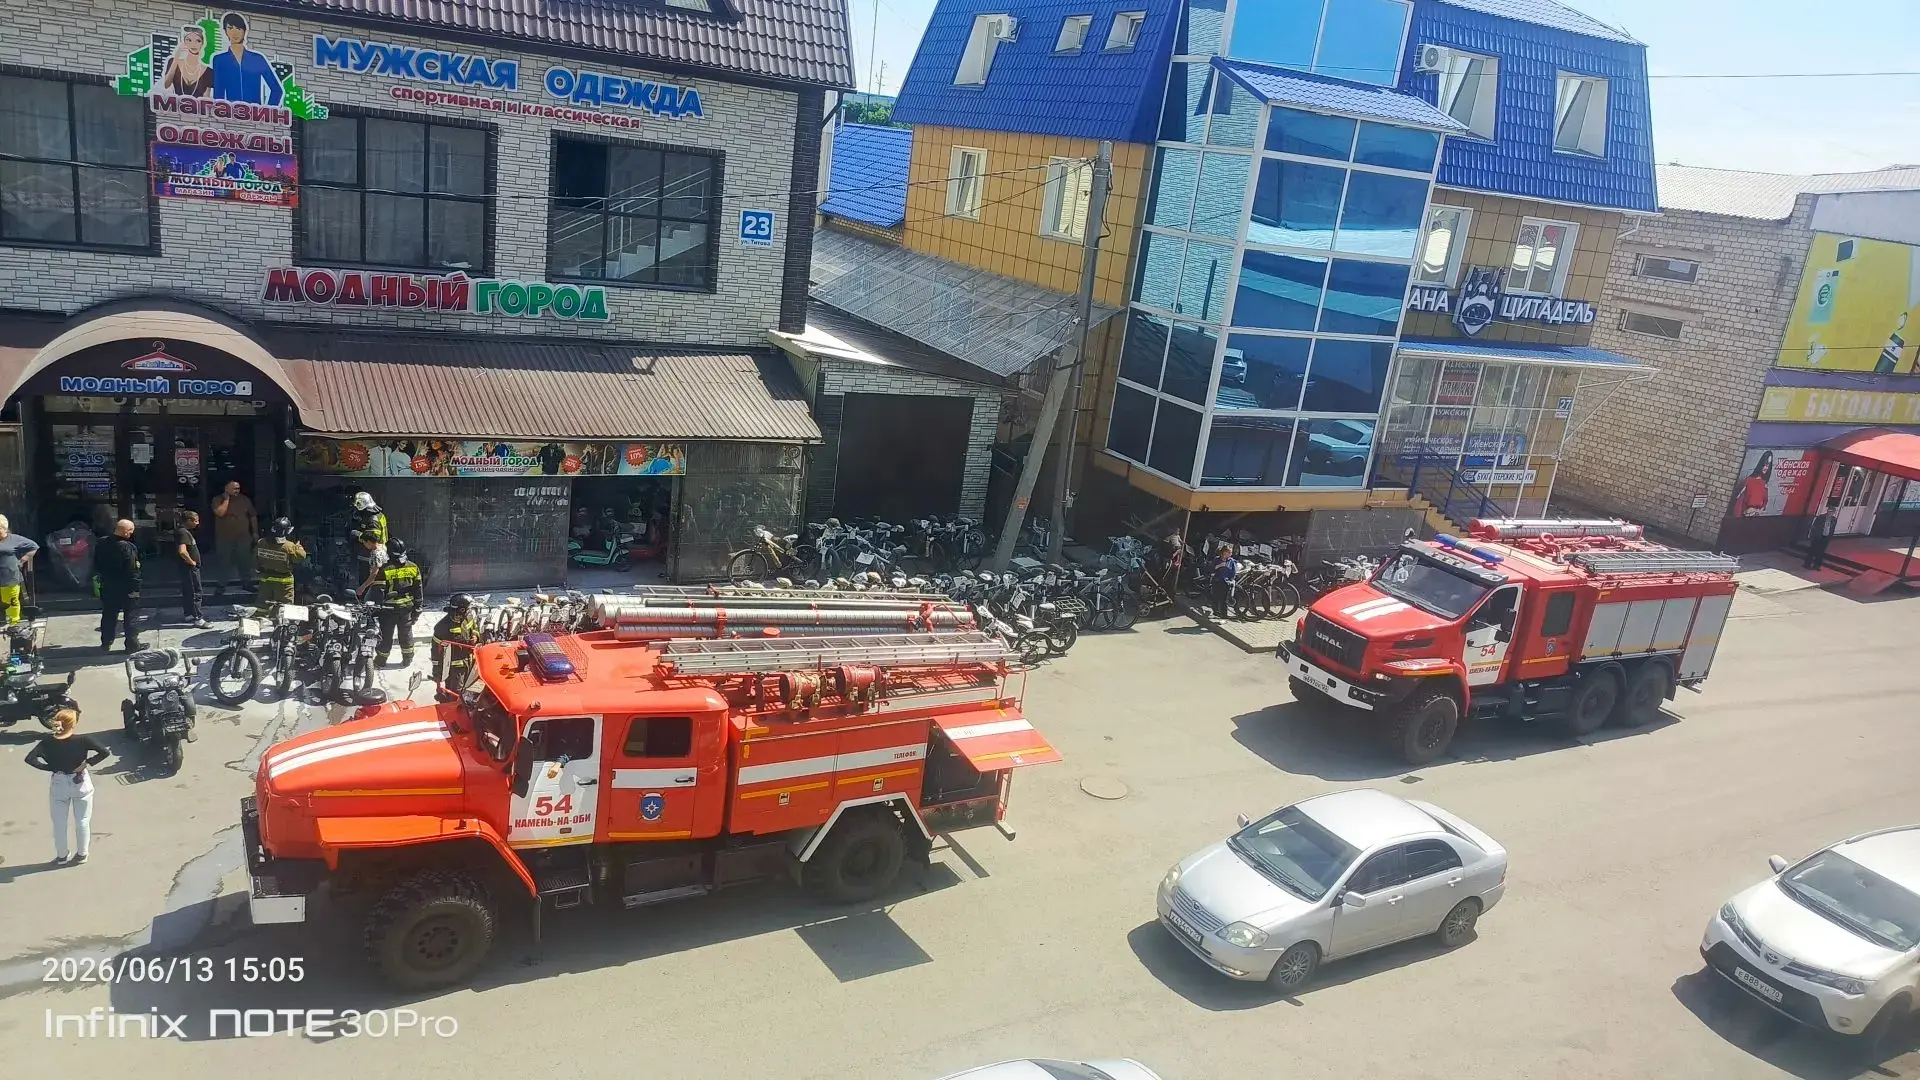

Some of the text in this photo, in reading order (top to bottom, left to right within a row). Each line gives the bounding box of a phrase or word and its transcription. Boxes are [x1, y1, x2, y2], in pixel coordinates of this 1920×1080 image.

[314, 35, 703, 119] МУЖСКАЯ ОДЕЖДА
[391, 87, 640, 128] спортивная и классическая
[175, 188, 214, 196] МАГАЗИН
[236, 181, 282, 192] ГОРОД
[744, 215, 770, 236] 23
[263, 269, 609, 319] МОДНЫЙ ГОРОД
[1503, 295, 1595, 325] ЦИТАДЕЛЬ
[61, 376, 253, 396] МОДНЫЙ ГОРОД
[1560, 399, 1572, 410] 27
[1804, 392, 1896, 420] БЫТОВАЯ
[450, 456, 538, 466] МОДНЫЙ ГОРОД
[1315, 631, 1343, 649] URAL
[1480, 645, 1496, 657] 54
[535, 794, 573, 816] 54
[514, 813, 591, 828] КАМЕНЬ-НА-ОБИ
